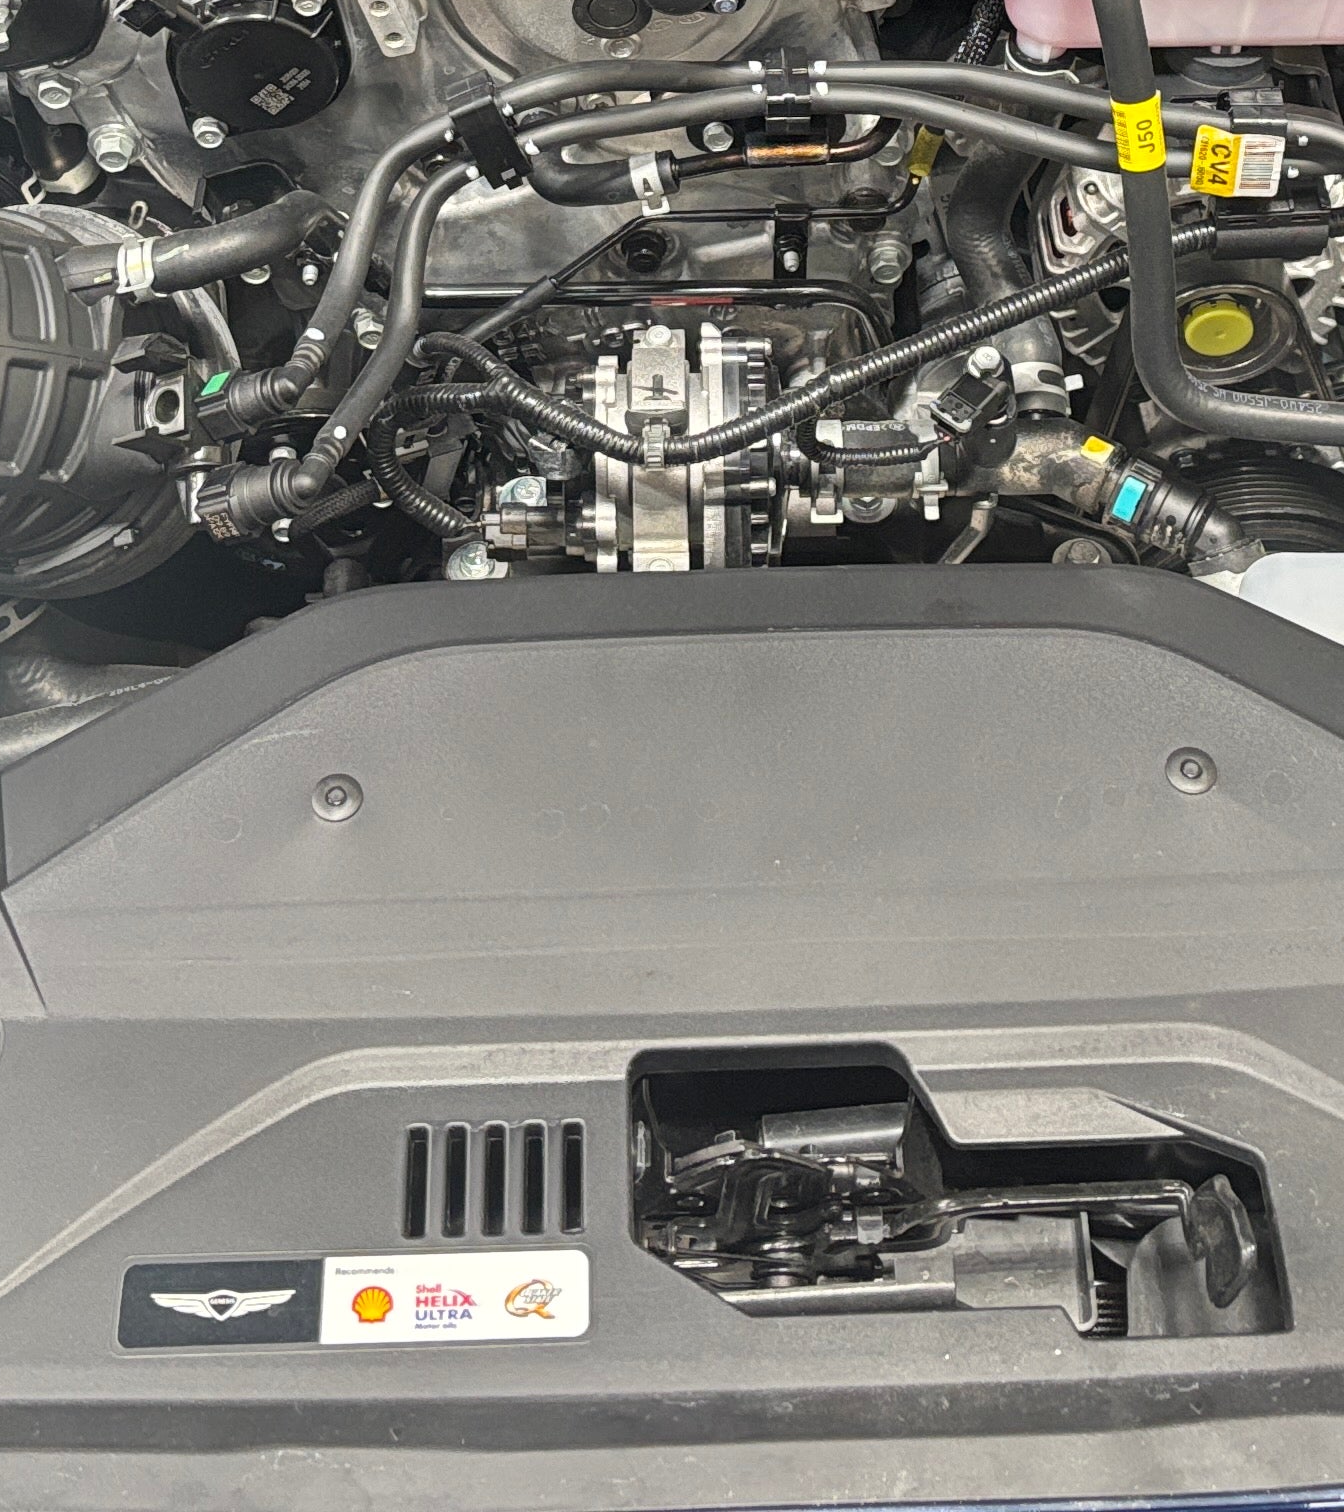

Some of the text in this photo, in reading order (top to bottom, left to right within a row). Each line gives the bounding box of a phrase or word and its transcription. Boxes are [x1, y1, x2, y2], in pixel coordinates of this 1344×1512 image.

[1136, 118, 1155, 154] J50
[1208, 143, 1232, 187] CV4
[415, 1284, 442, 1294] Shell
[415, 1294, 476, 1308] HELIX
[415, 1308, 473, 1321] ULTRA
